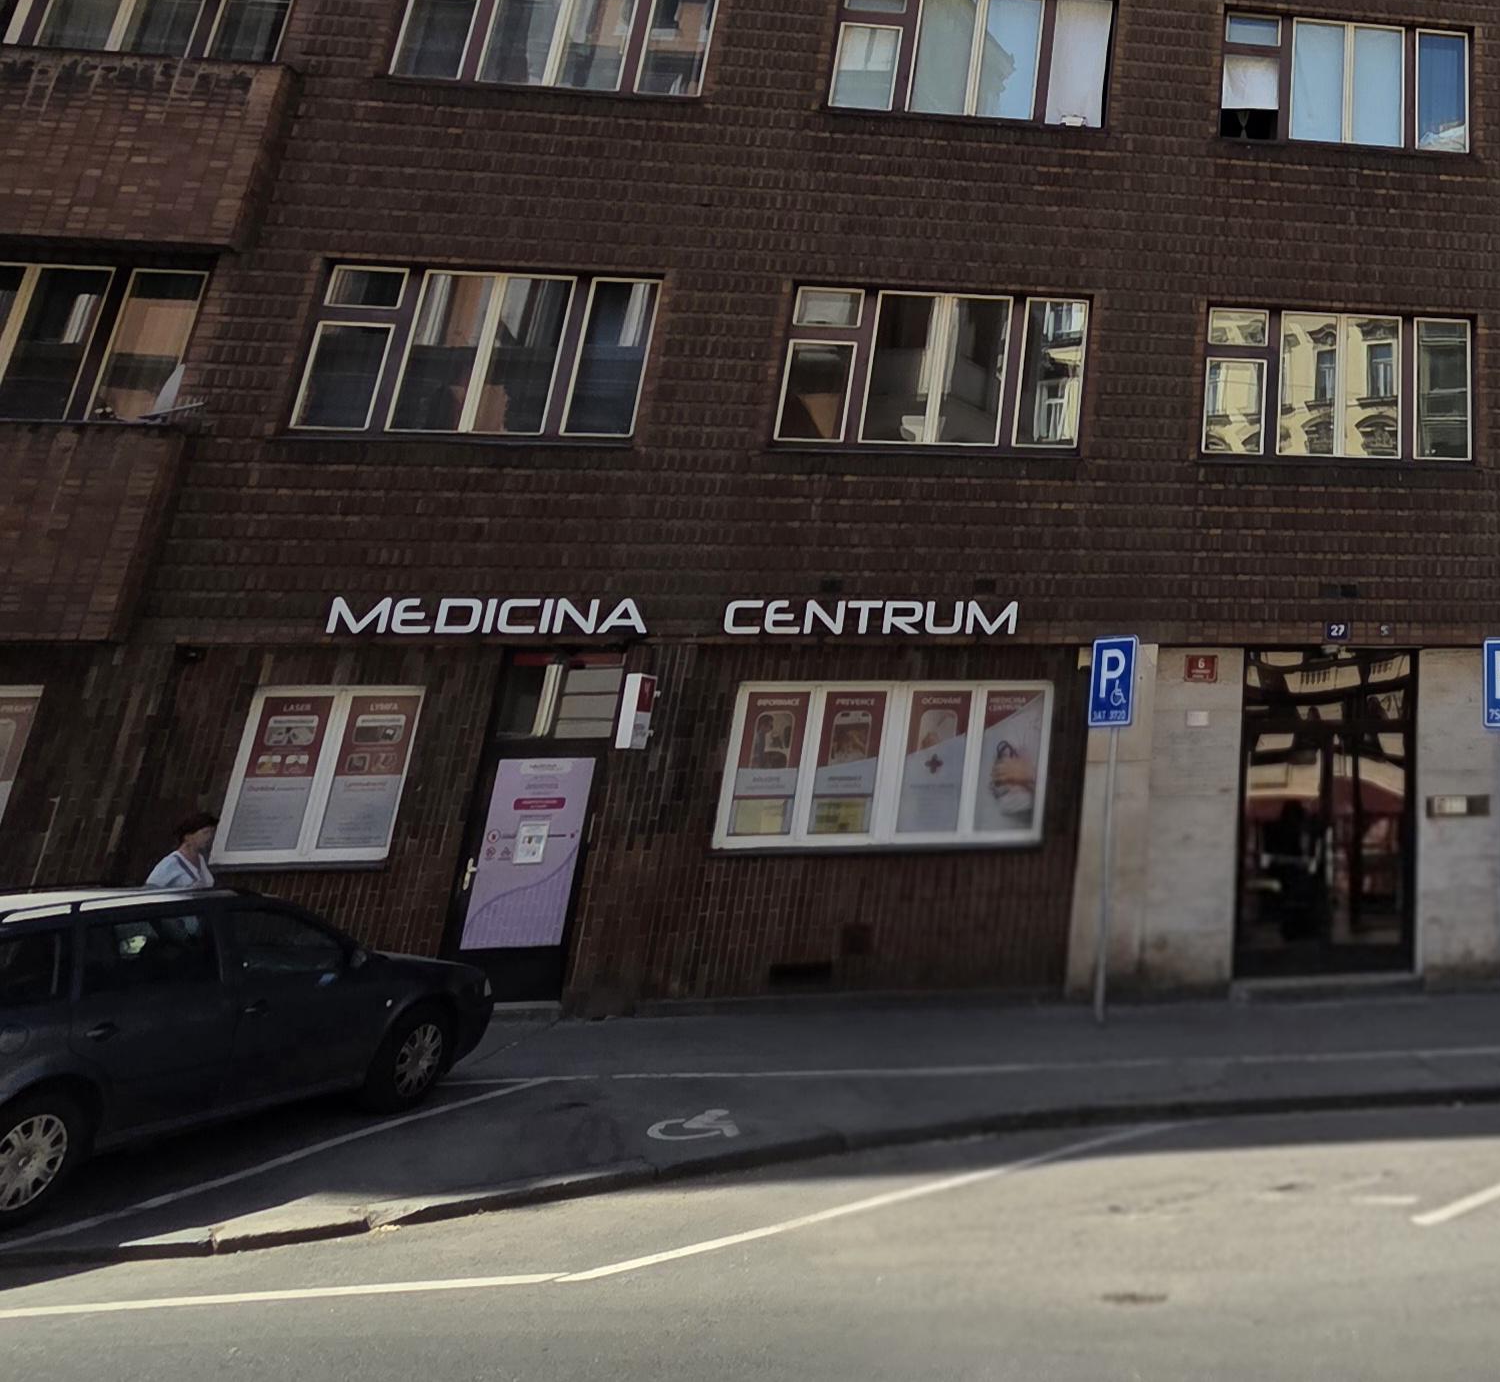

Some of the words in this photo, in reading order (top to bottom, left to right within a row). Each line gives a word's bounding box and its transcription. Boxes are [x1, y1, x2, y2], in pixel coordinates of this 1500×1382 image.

[325, 596, 648, 634] MEDICINA
[723, 599, 1019, 635] CENTRUM
[1330, 624, 1346, 636] 27
[1099, 649, 1126, 698] P
[282, 703, 312, 712] LASER
[835, 698, 876, 706] PREVENCE
